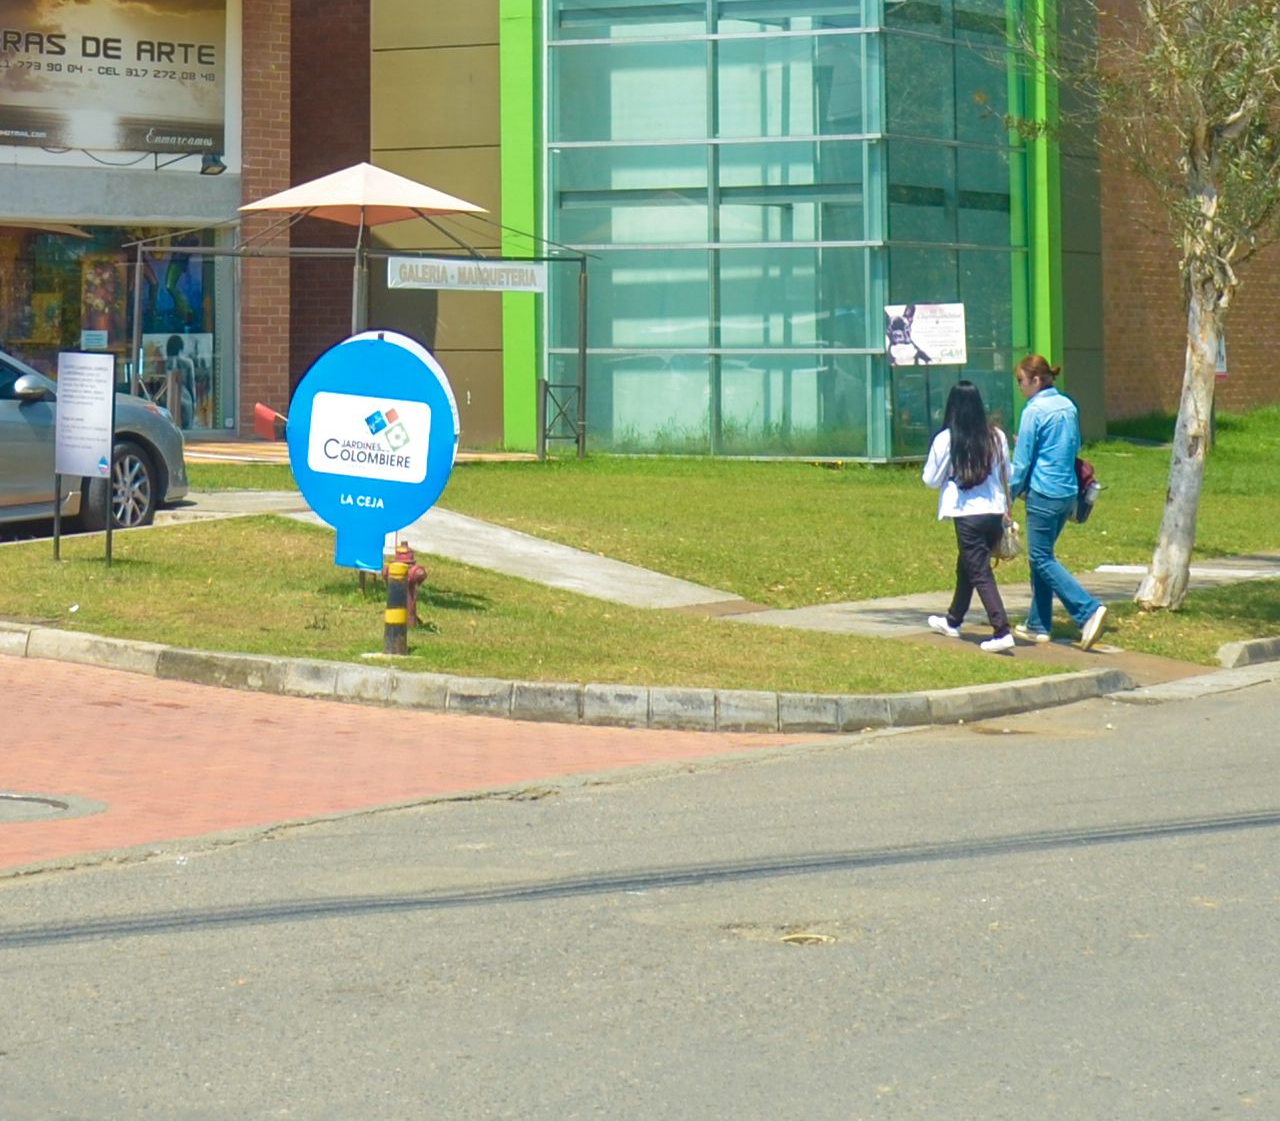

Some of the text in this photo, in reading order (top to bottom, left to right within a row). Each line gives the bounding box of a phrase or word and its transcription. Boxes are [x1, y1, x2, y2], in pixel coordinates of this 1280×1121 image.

[81, 35, 122, 59] DE
[136, 40, 215, 66] ARTE
[18, 60, 42, 71] 773
[46, 62, 63, 73] 90
[67, 63, 83, 74] 04
[97, 65, 120, 76] CEL
[125, 67, 148, 78] 317
[152, 69, 177, 80] 272
[399, 263, 448, 283] GALERIA
[457, 266, 537, 286] MARQUETERIA
[324, 438, 411, 469] COLOMBIERE
[341, 440, 381, 452] JARDINES
[340, 494, 385, 509] LA CEJA
